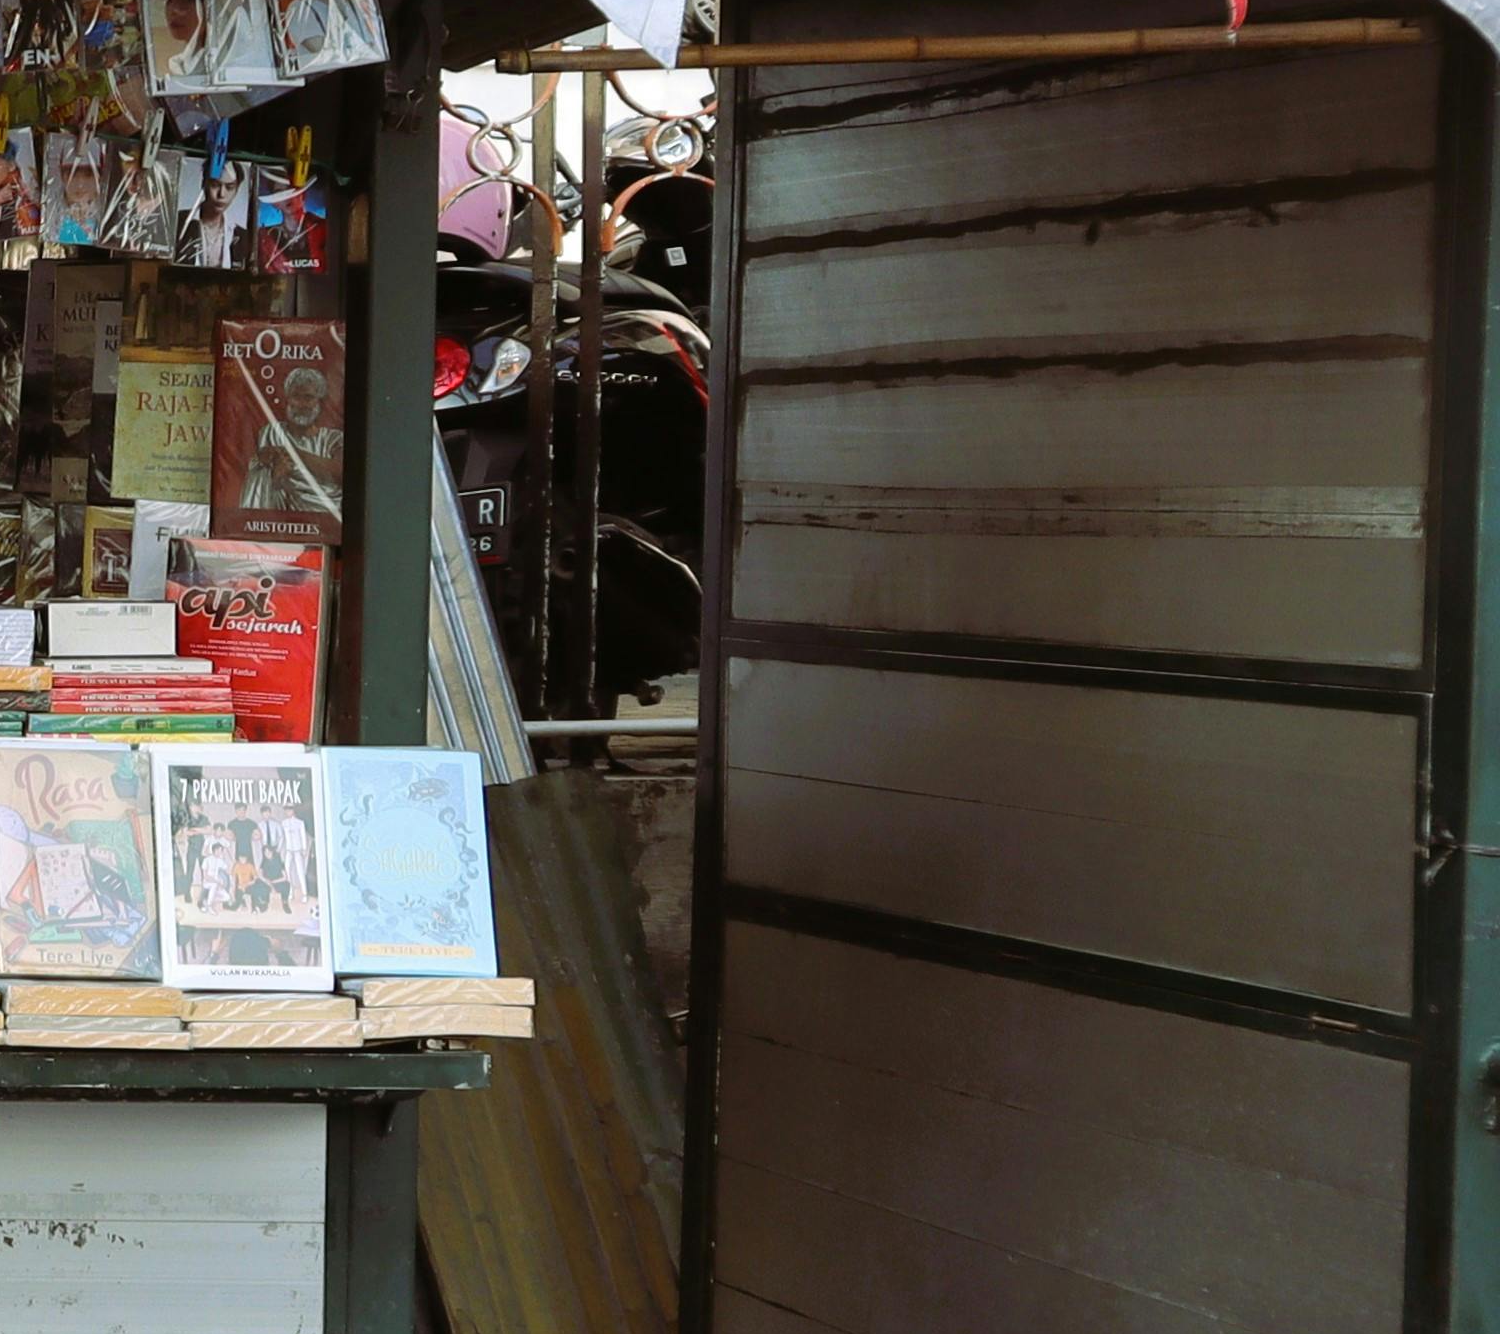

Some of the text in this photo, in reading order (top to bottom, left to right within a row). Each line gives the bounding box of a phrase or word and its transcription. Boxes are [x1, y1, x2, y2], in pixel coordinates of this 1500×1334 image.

[223, 328, 324, 362] RETORIKA
[478, 498, 494, 525] R
[244, 519, 320, 536] ARISTOTELES
[179, 577, 274, 634] api
[225, 615, 304, 636] sejarah
[15, 755, 108, 819] Rasa
[180, 778, 302, 803] 7 PRAJURIT BAPAK
[36, 948, 114, 966] Tere Liye
